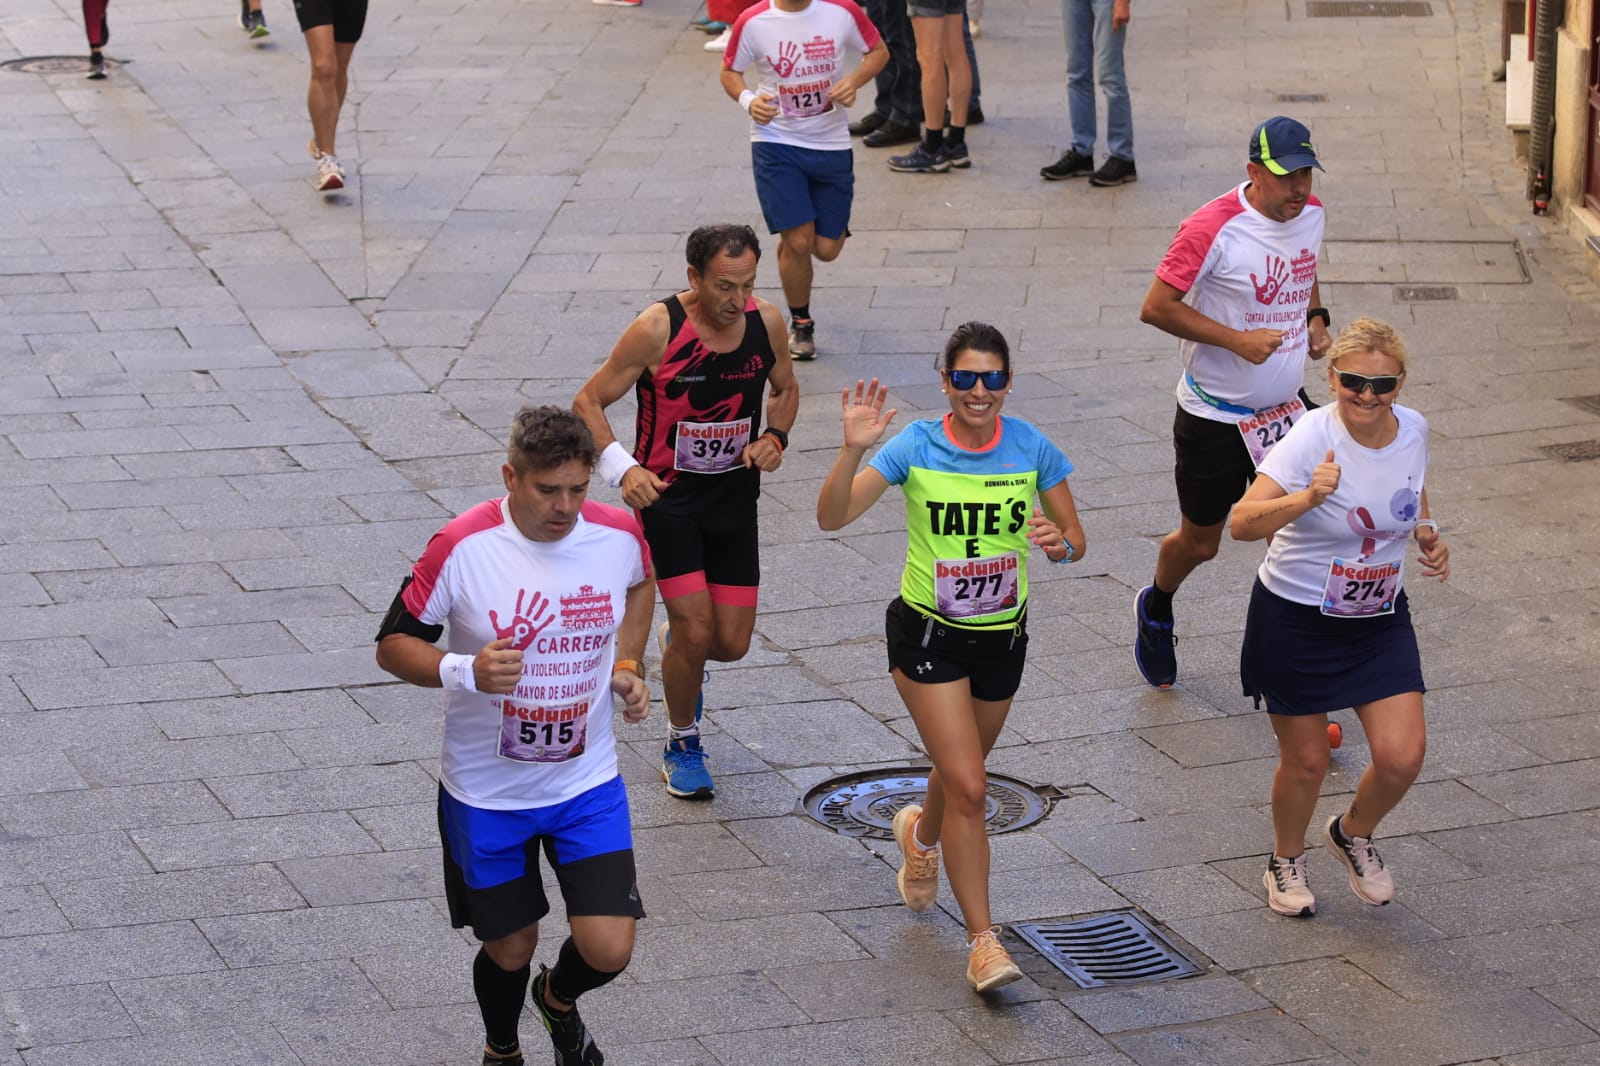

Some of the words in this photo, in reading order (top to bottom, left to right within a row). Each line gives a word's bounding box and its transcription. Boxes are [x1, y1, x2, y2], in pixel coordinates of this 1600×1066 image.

[778, 80, 831, 95] bedunia
[791, 92, 822, 108] 121
[1277, 287, 1312, 305] CARRE
[1244, 312, 1265, 323] CONTRA
[1238, 399, 1304, 433] bedunia
[679, 424, 750, 439] bedunia
[1256, 415, 1294, 449] 221
[692, 437, 736, 458] 394
[965, 538, 981, 558] E
[936, 556, 1017, 578] bedunia
[1331, 563, 1400, 581] bedunia
[954, 573, 1003, 601] 277
[1342, 579, 1386, 601] 274
[536, 634, 610, 654] CARRERA
[531, 662, 570, 677] VIOLENCIA
[572, 661, 582, 674] DE
[517, 684, 546, 700] MAYOR
[548, 685, 559, 700] DE
[503, 700, 589, 723] bedunia
[519, 720, 574, 746] 515
